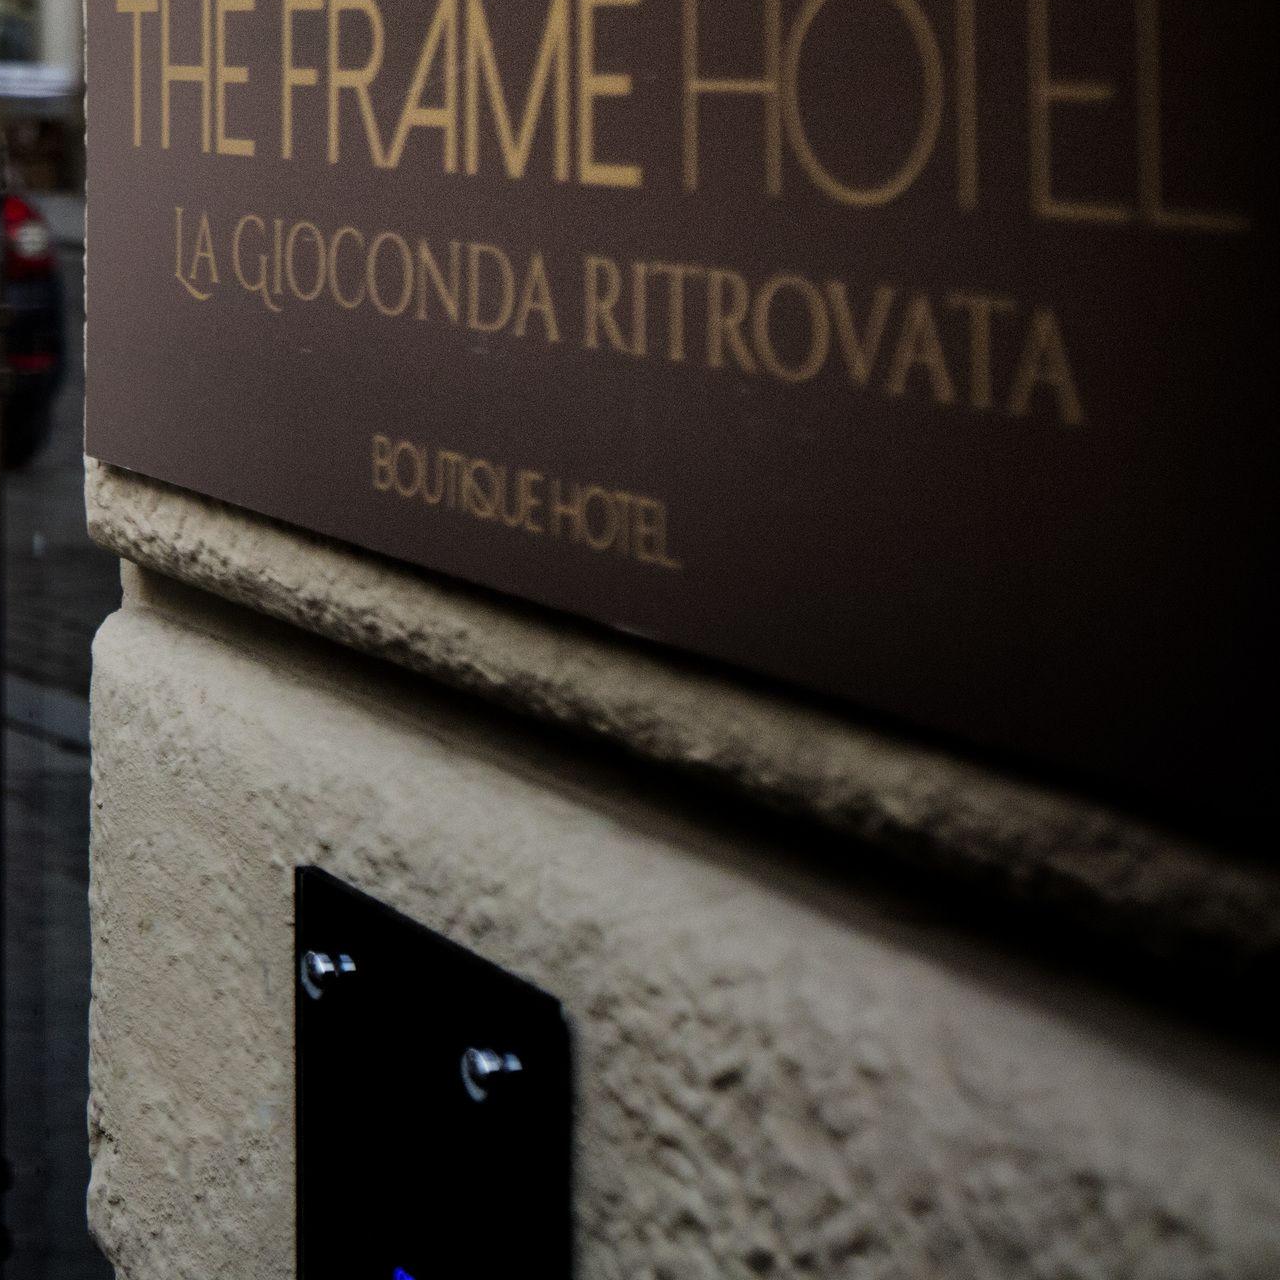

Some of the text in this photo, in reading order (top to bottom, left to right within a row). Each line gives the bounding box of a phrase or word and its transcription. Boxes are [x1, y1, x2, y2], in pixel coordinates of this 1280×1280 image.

[174, 206, 1086, 427] LA GIOCONDA RITROVATA
[370, 431, 684, 572] BOUTIQUE HOTEL
